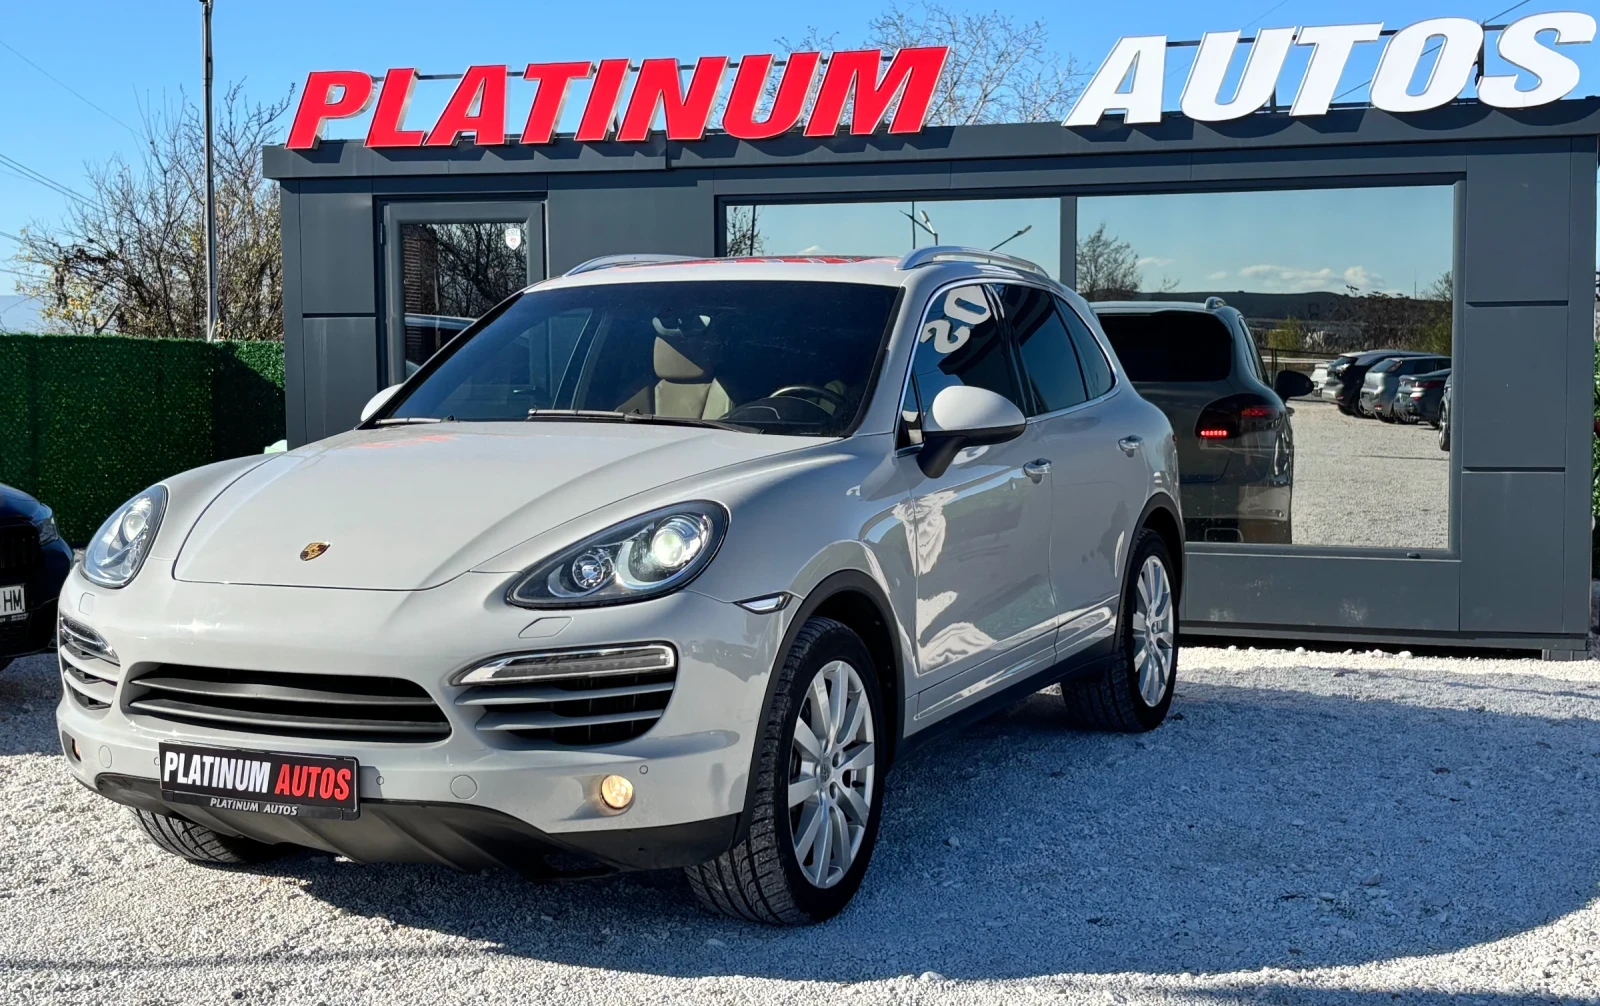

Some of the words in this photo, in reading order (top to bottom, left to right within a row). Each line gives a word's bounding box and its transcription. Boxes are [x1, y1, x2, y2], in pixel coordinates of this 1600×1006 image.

[286, 45, 950, 150] PLATINUM
[1062, 11, 1597, 127] AUTOS
[3, 589, 23, 612] HM
[163, 751, 272, 794] PLATINUM
[274, 763, 352, 801] AUTOS
[209, 797, 259, 812] PLATINUM
[263, 803, 299, 816] AUTOS
